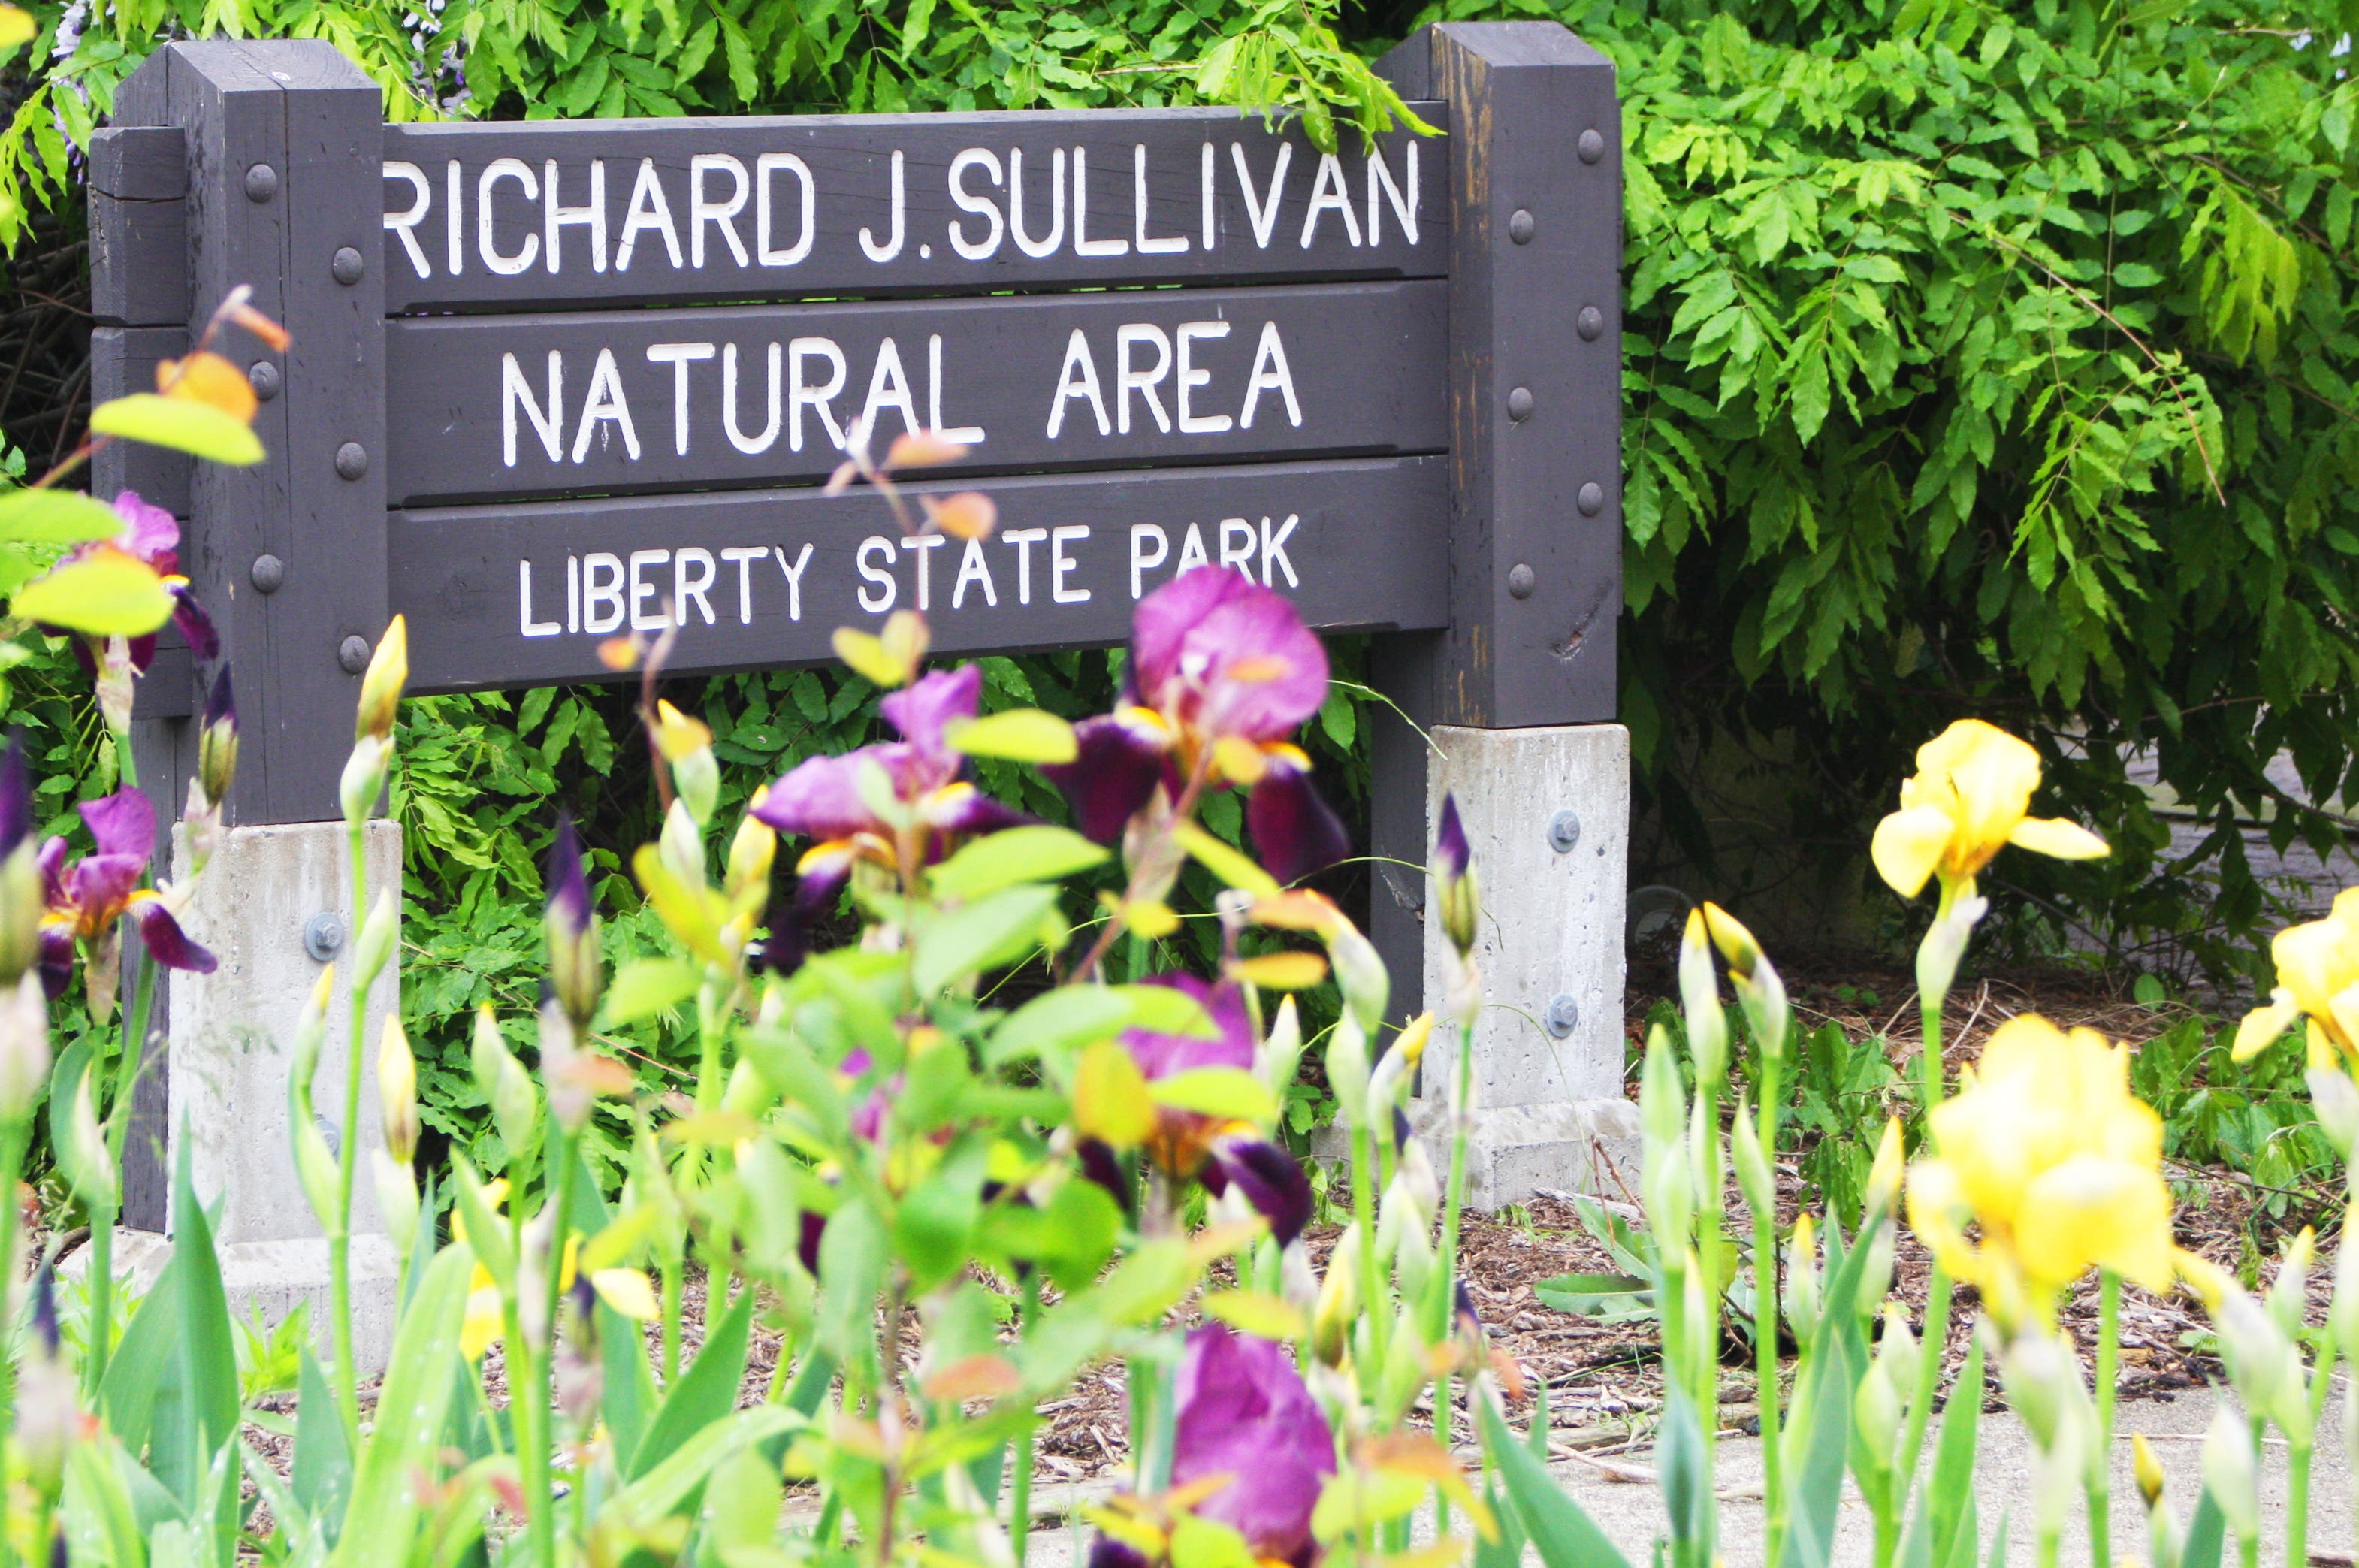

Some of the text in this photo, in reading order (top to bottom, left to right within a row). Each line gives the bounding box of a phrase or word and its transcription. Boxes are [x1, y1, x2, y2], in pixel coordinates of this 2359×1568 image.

[382, 140, 1419, 279] RICHARD J. SULLIVAN
[502, 320, 1303, 467] NATURAL AREA
[520, 513, 1300, 636] LIBERTY STATE PARK
